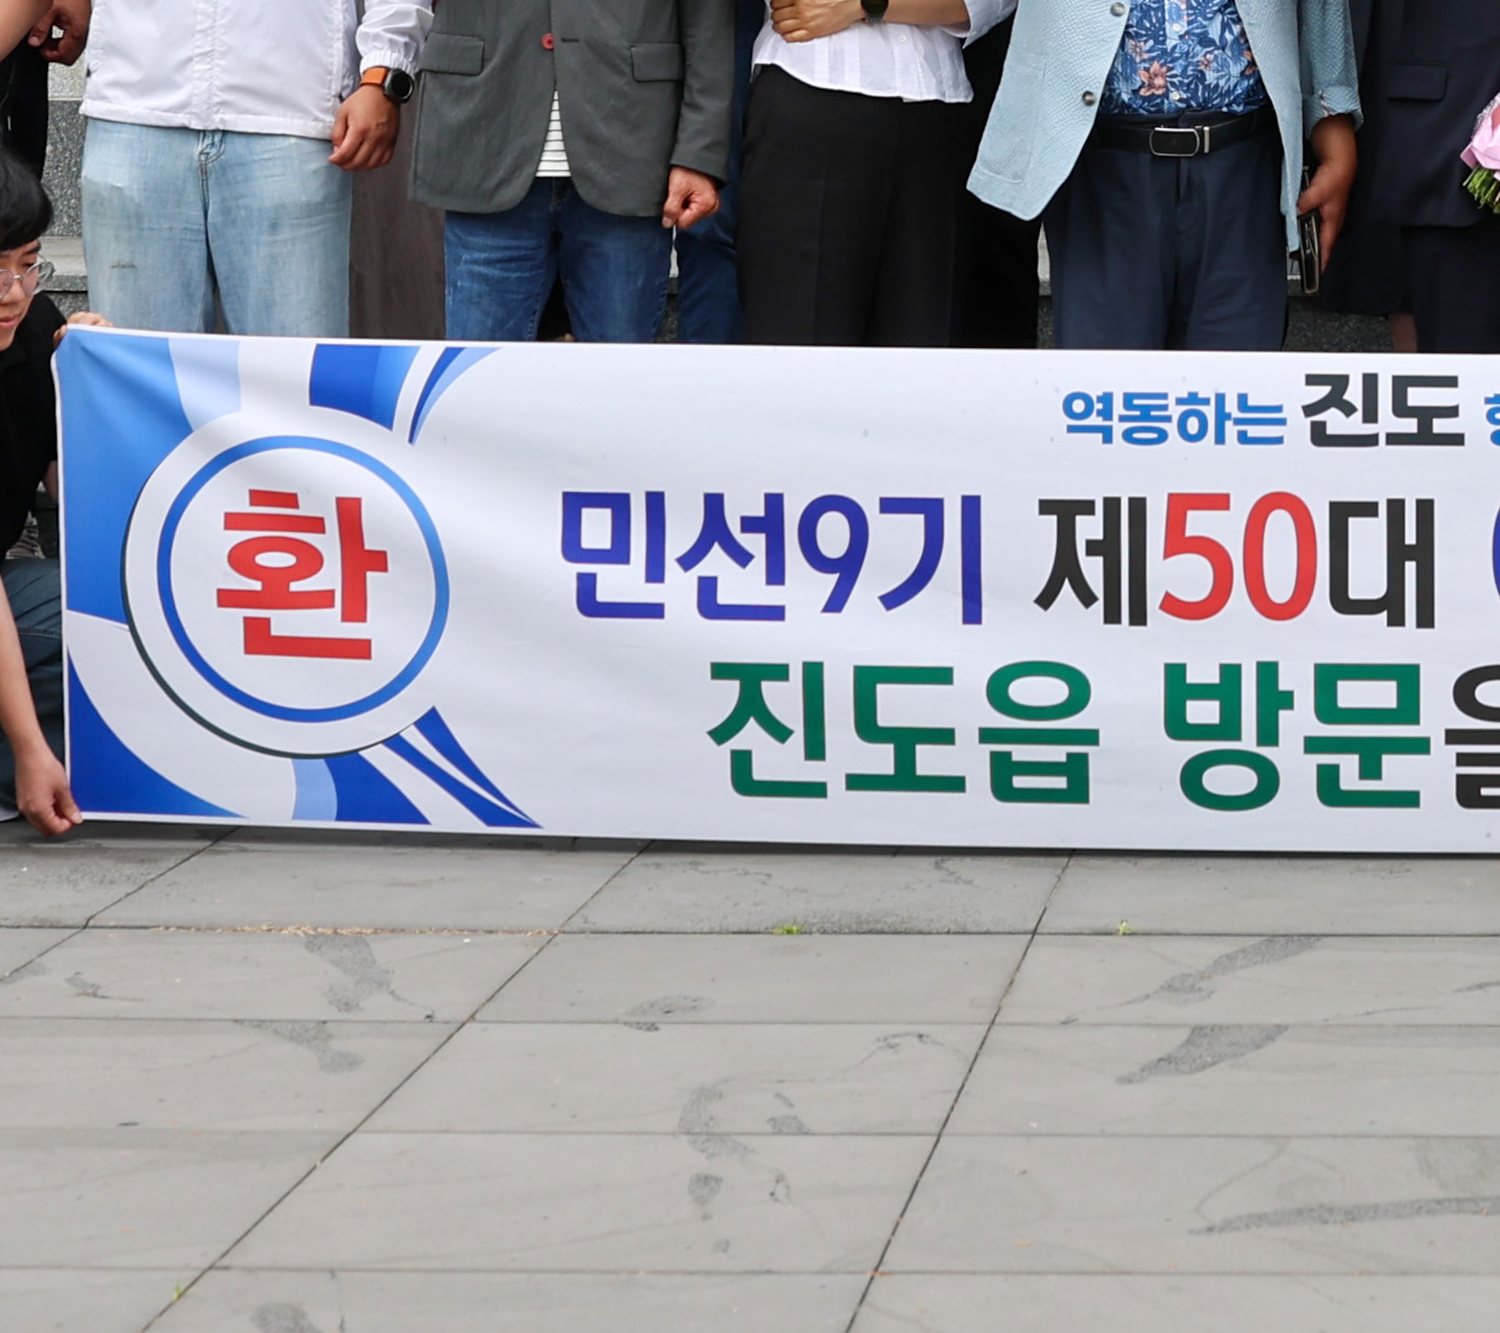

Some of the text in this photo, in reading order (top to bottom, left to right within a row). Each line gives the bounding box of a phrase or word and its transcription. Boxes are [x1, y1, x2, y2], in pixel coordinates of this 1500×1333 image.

[1062, 391, 1288, 446] 역동하는
[1301, 373, 1465, 448] 진도
[215, 488, 389, 661] 환
[560, 491, 984, 625] 민선9기
[1033, 491, 1435, 629] 제50대
[707, 661, 1100, 806] 진도읍
